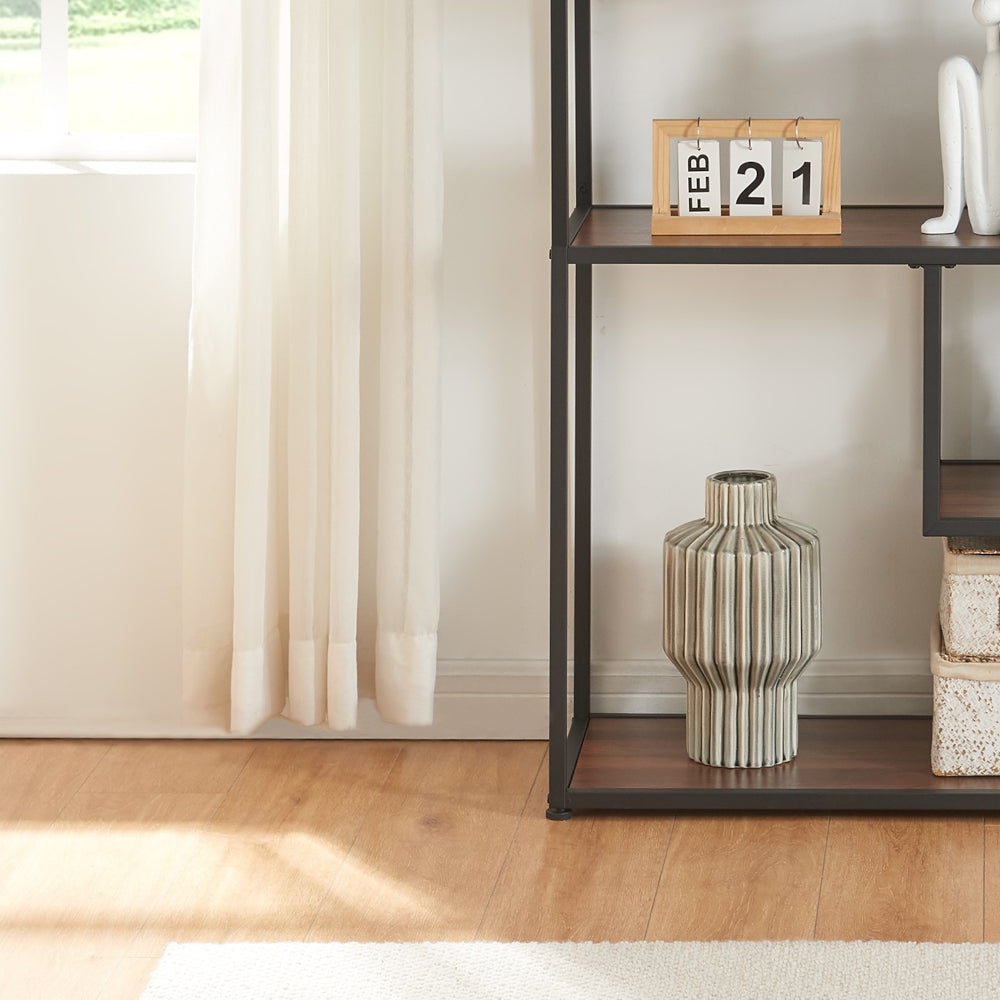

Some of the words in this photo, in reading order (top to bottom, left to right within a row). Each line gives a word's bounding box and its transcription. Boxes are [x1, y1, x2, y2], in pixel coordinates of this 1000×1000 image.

[688, 154, 710, 212] FEB
[736, 162, 765, 205] 2
[792, 162, 811, 205] 1
